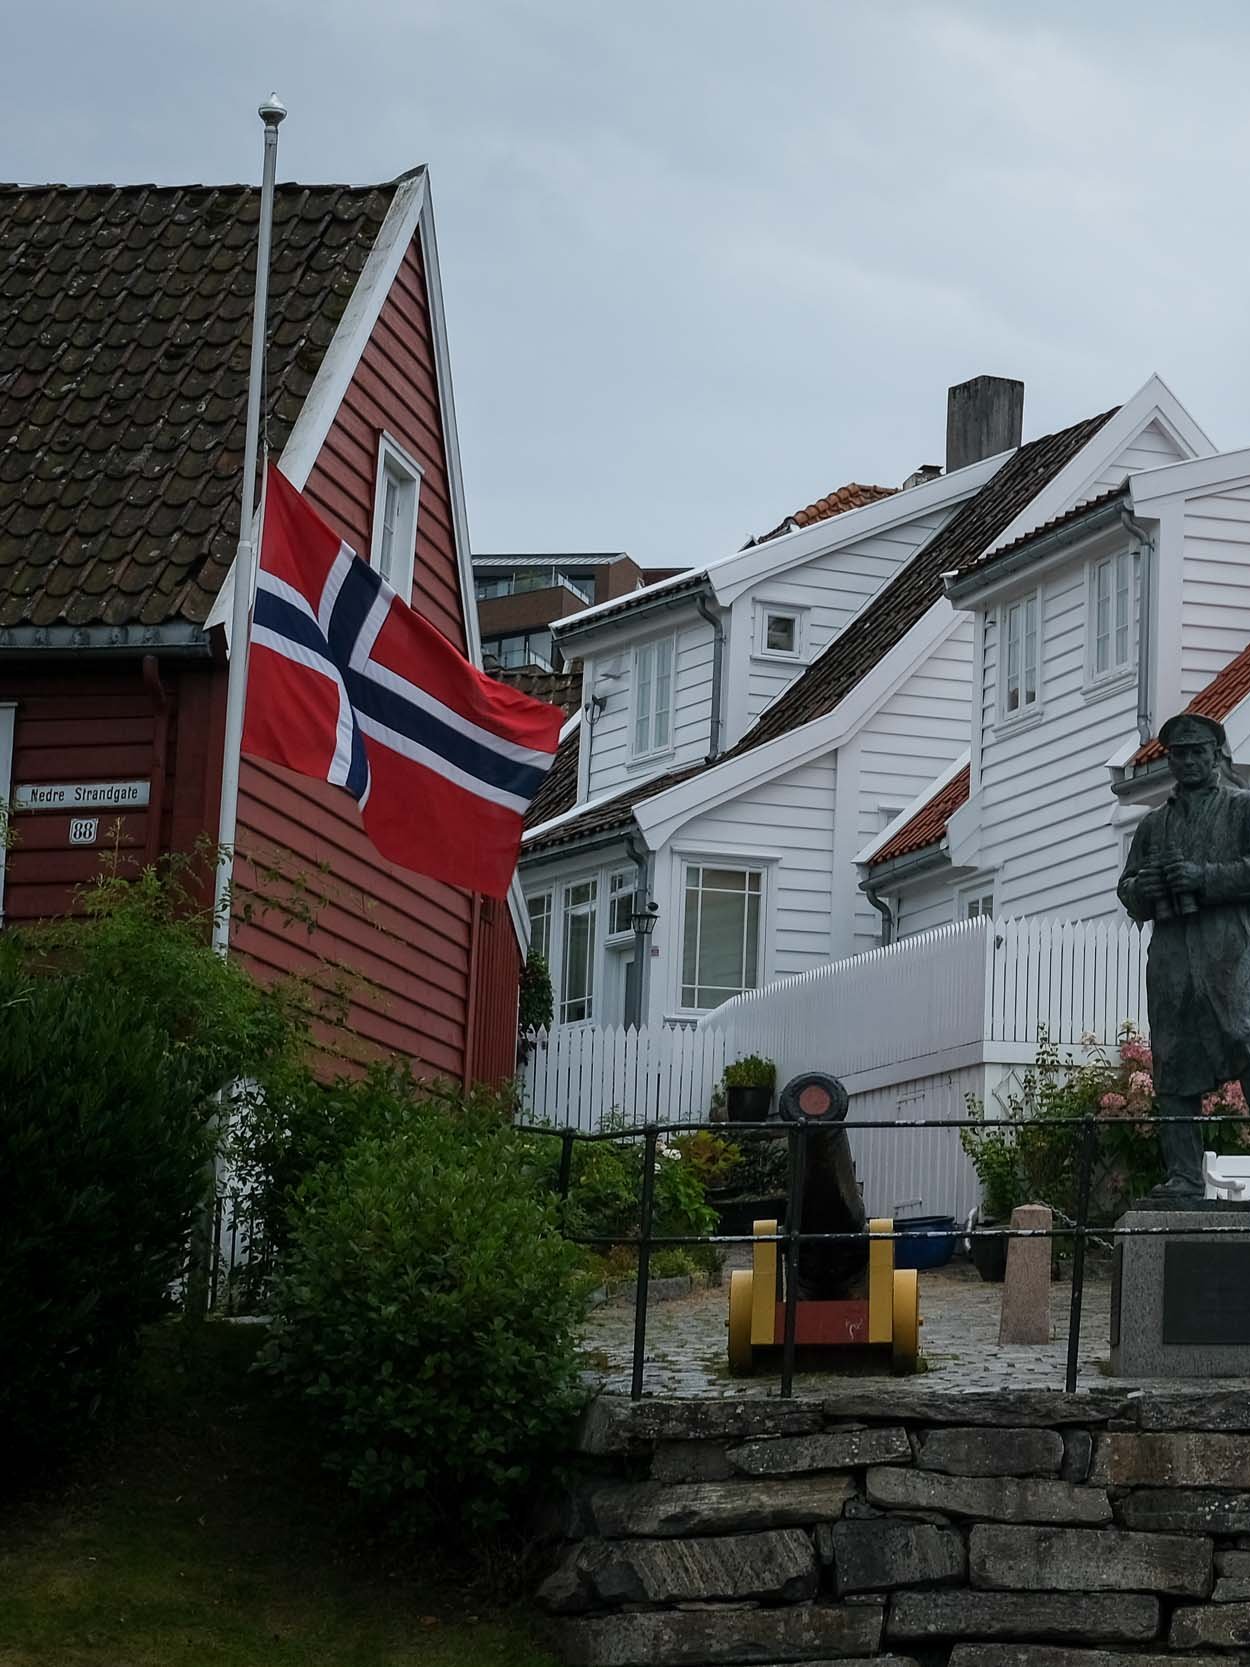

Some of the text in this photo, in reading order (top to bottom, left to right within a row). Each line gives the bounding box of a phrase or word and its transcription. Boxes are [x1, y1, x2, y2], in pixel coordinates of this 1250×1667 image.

[31, 786, 138, 803] Nedre Strandgate
[73, 822, 93, 839] 88
